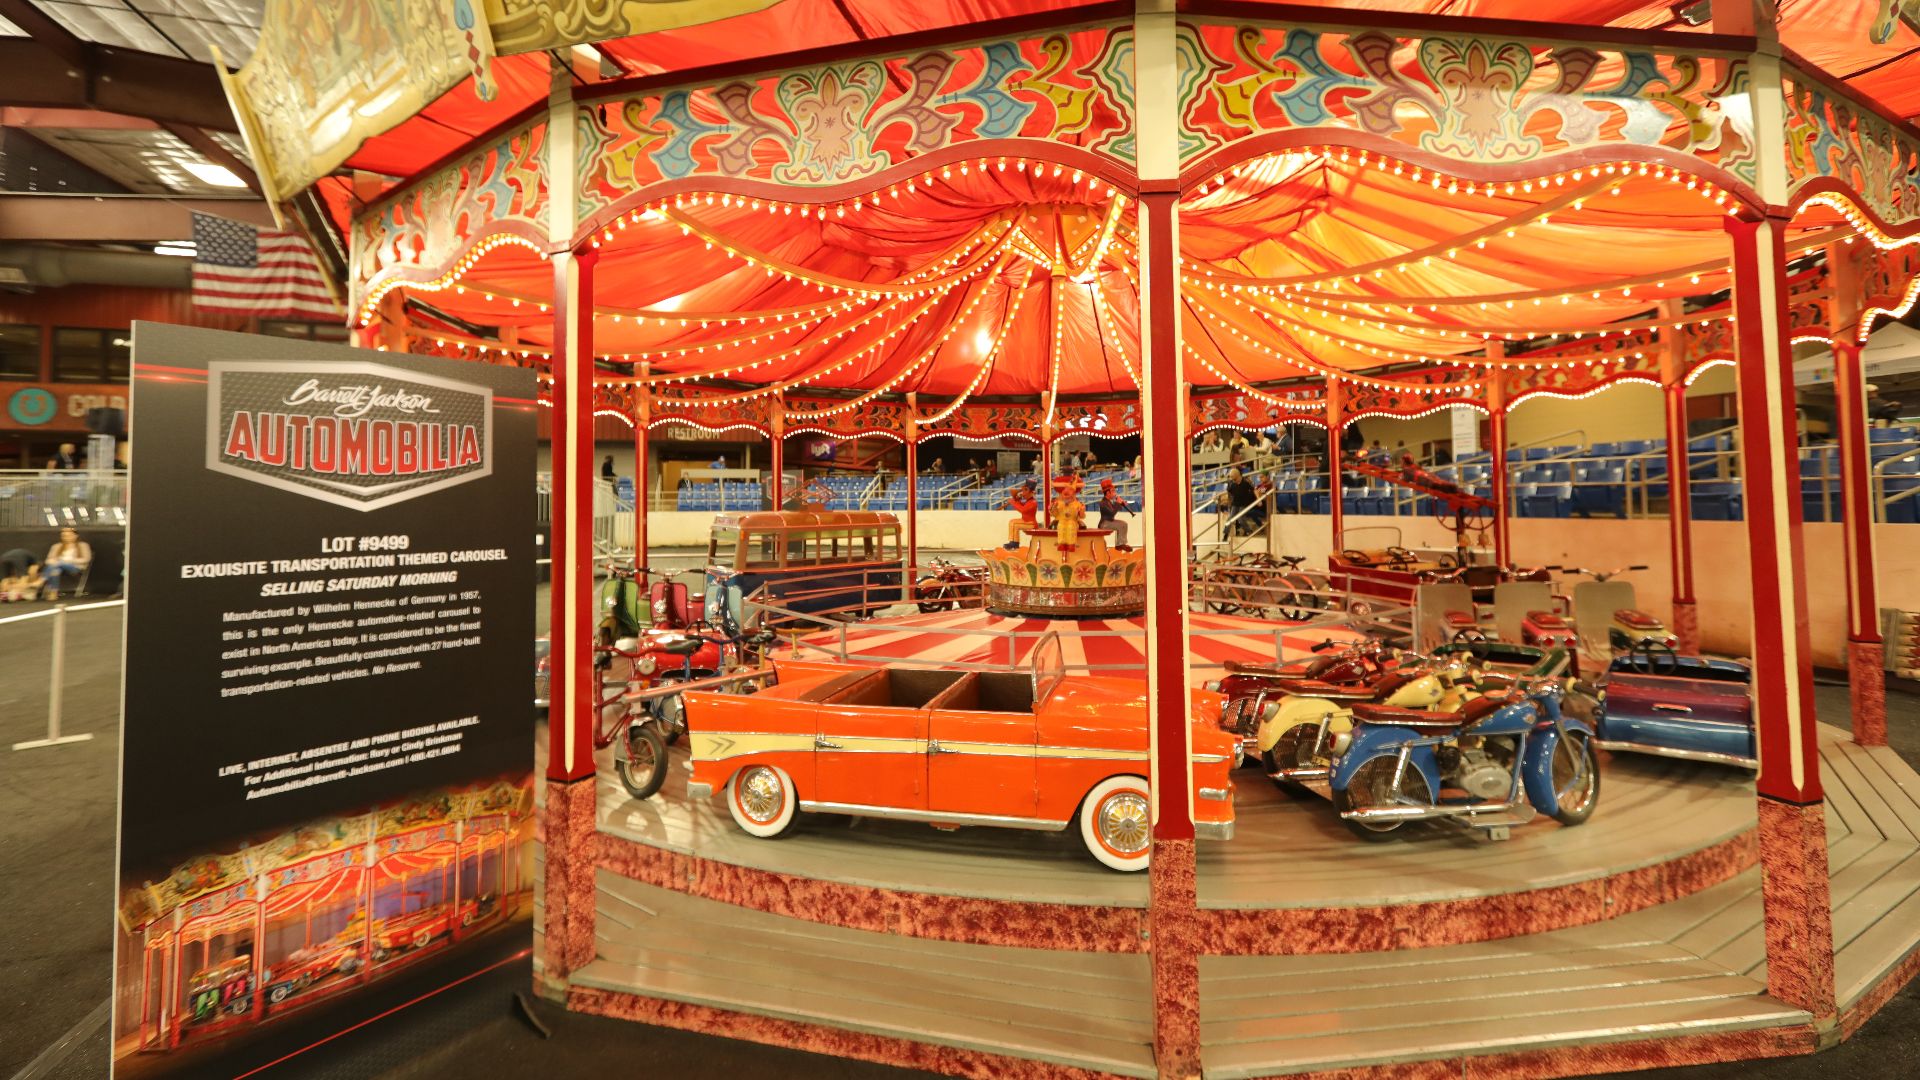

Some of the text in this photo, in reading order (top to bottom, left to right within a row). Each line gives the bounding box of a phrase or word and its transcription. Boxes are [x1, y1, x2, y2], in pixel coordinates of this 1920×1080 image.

[282, 378, 440, 417] Barrett-Jackson
[224, 410, 481, 476] AUTOMOBILIA
[321, 535, 410, 553] LOT #9499
[181, 549, 508, 579] EXQUISITE TRANSPORTATION THEMED CAROUSEL
[260, 571, 459, 597] SELLING SATURDAY MORNING
[222, 607, 295, 622] Manufactured
[297, 606, 311, 617] by
[313, 602, 351, 614] Wilhelm
[353, 598, 397, 611] Hennecke
[398, 597, 408, 606] of
[410, 594, 447, 606] Germany
[448, 593, 458, 602] in
[222, 606, 481, 641] this is the only Hennecke automotive-related carousel to
[221, 648, 249, 660] exist
[249, 646, 261, 657] in
[261, 643, 291, 655] North
[291, 639, 332, 652] America
[360, 634, 368, 643] It
[368, 633, 377, 642] is
[378, 627, 425, 641] considered
[424, 626, 434, 636] to
[434, 625, 445, 634] be
[446, 624, 459, 633] the
[459, 621, 481, 631] finest
[221, 635, 481, 679] surviving example. Beautifully constructed with 27 hand-built
[221, 660, 423, 698] transportation-related vehicles. No Reserve.
[219, 715, 481, 777] LIVE, INTERNET, ABSENTEE AND PHONE BIDDING AVAILABLE.
[243, 732, 463, 787] For Additional Information: Rory or Cindy Brinkman
[245, 757, 405, 800] Automobilia@Barrett-Jackson.com
